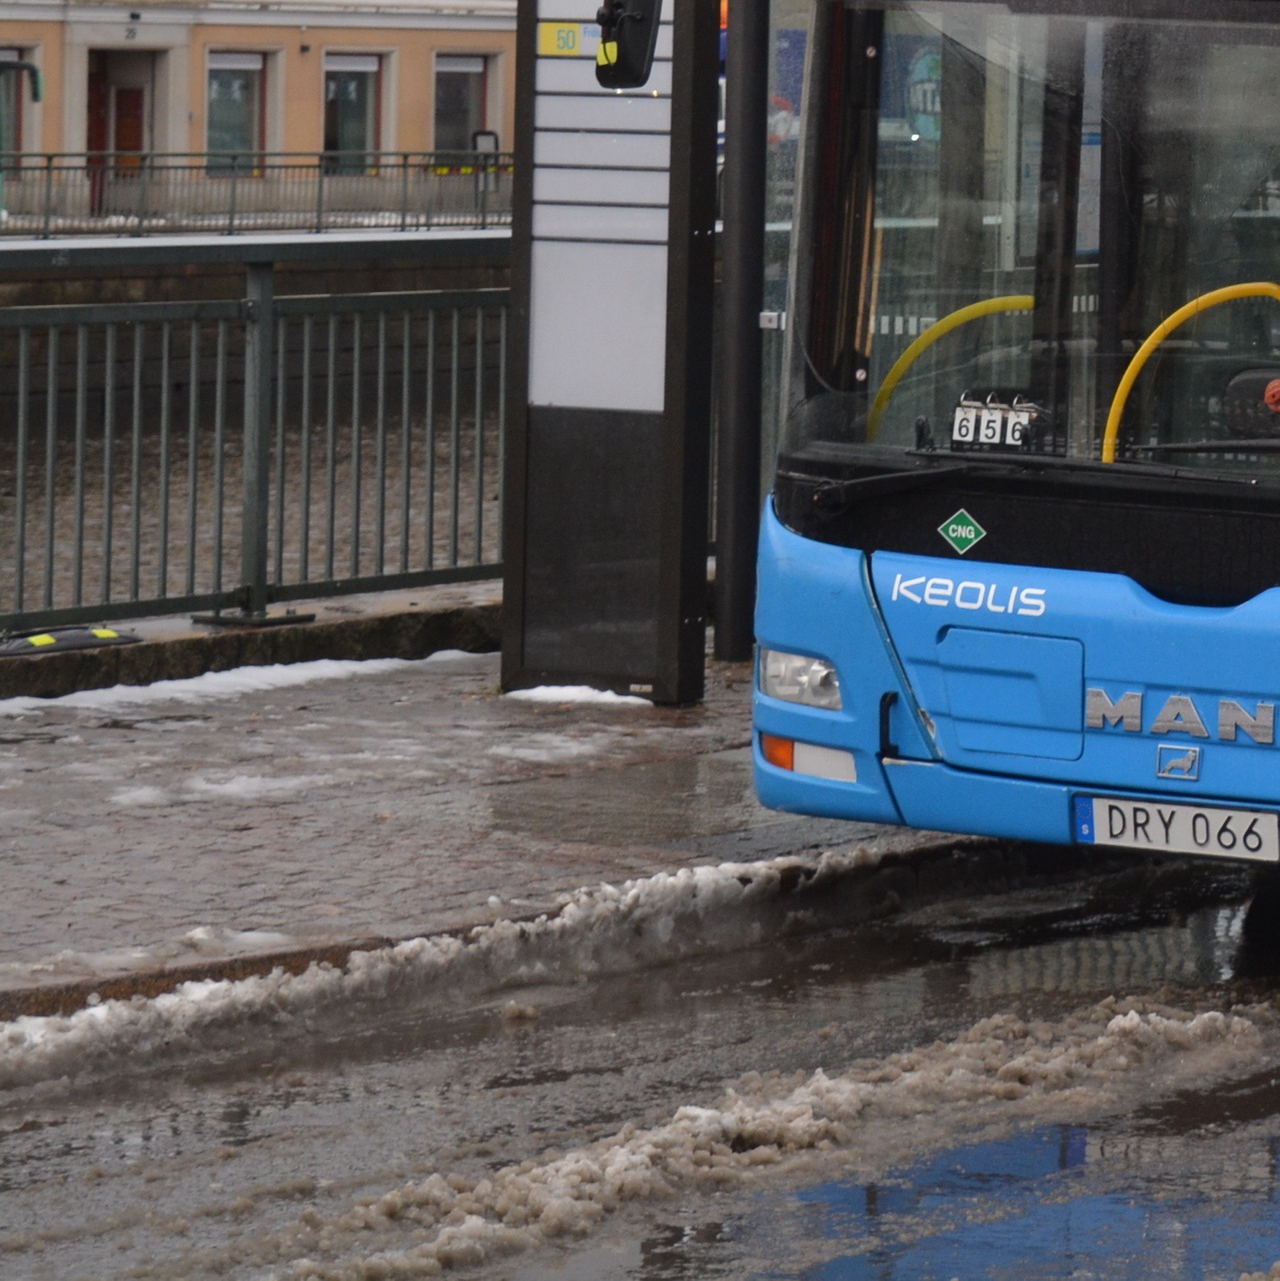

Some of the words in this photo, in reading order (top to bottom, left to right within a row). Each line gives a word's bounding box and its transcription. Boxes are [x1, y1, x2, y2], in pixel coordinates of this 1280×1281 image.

[556, 28, 577, 50] 50
[948, 523, 976, 539] CNG
[1086, 687, 1275, 745] MAN
[1080, 824, 1090, 836] S
[1107, 804, 1177, 845] DRY
[1191, 812, 1264, 853] 066
